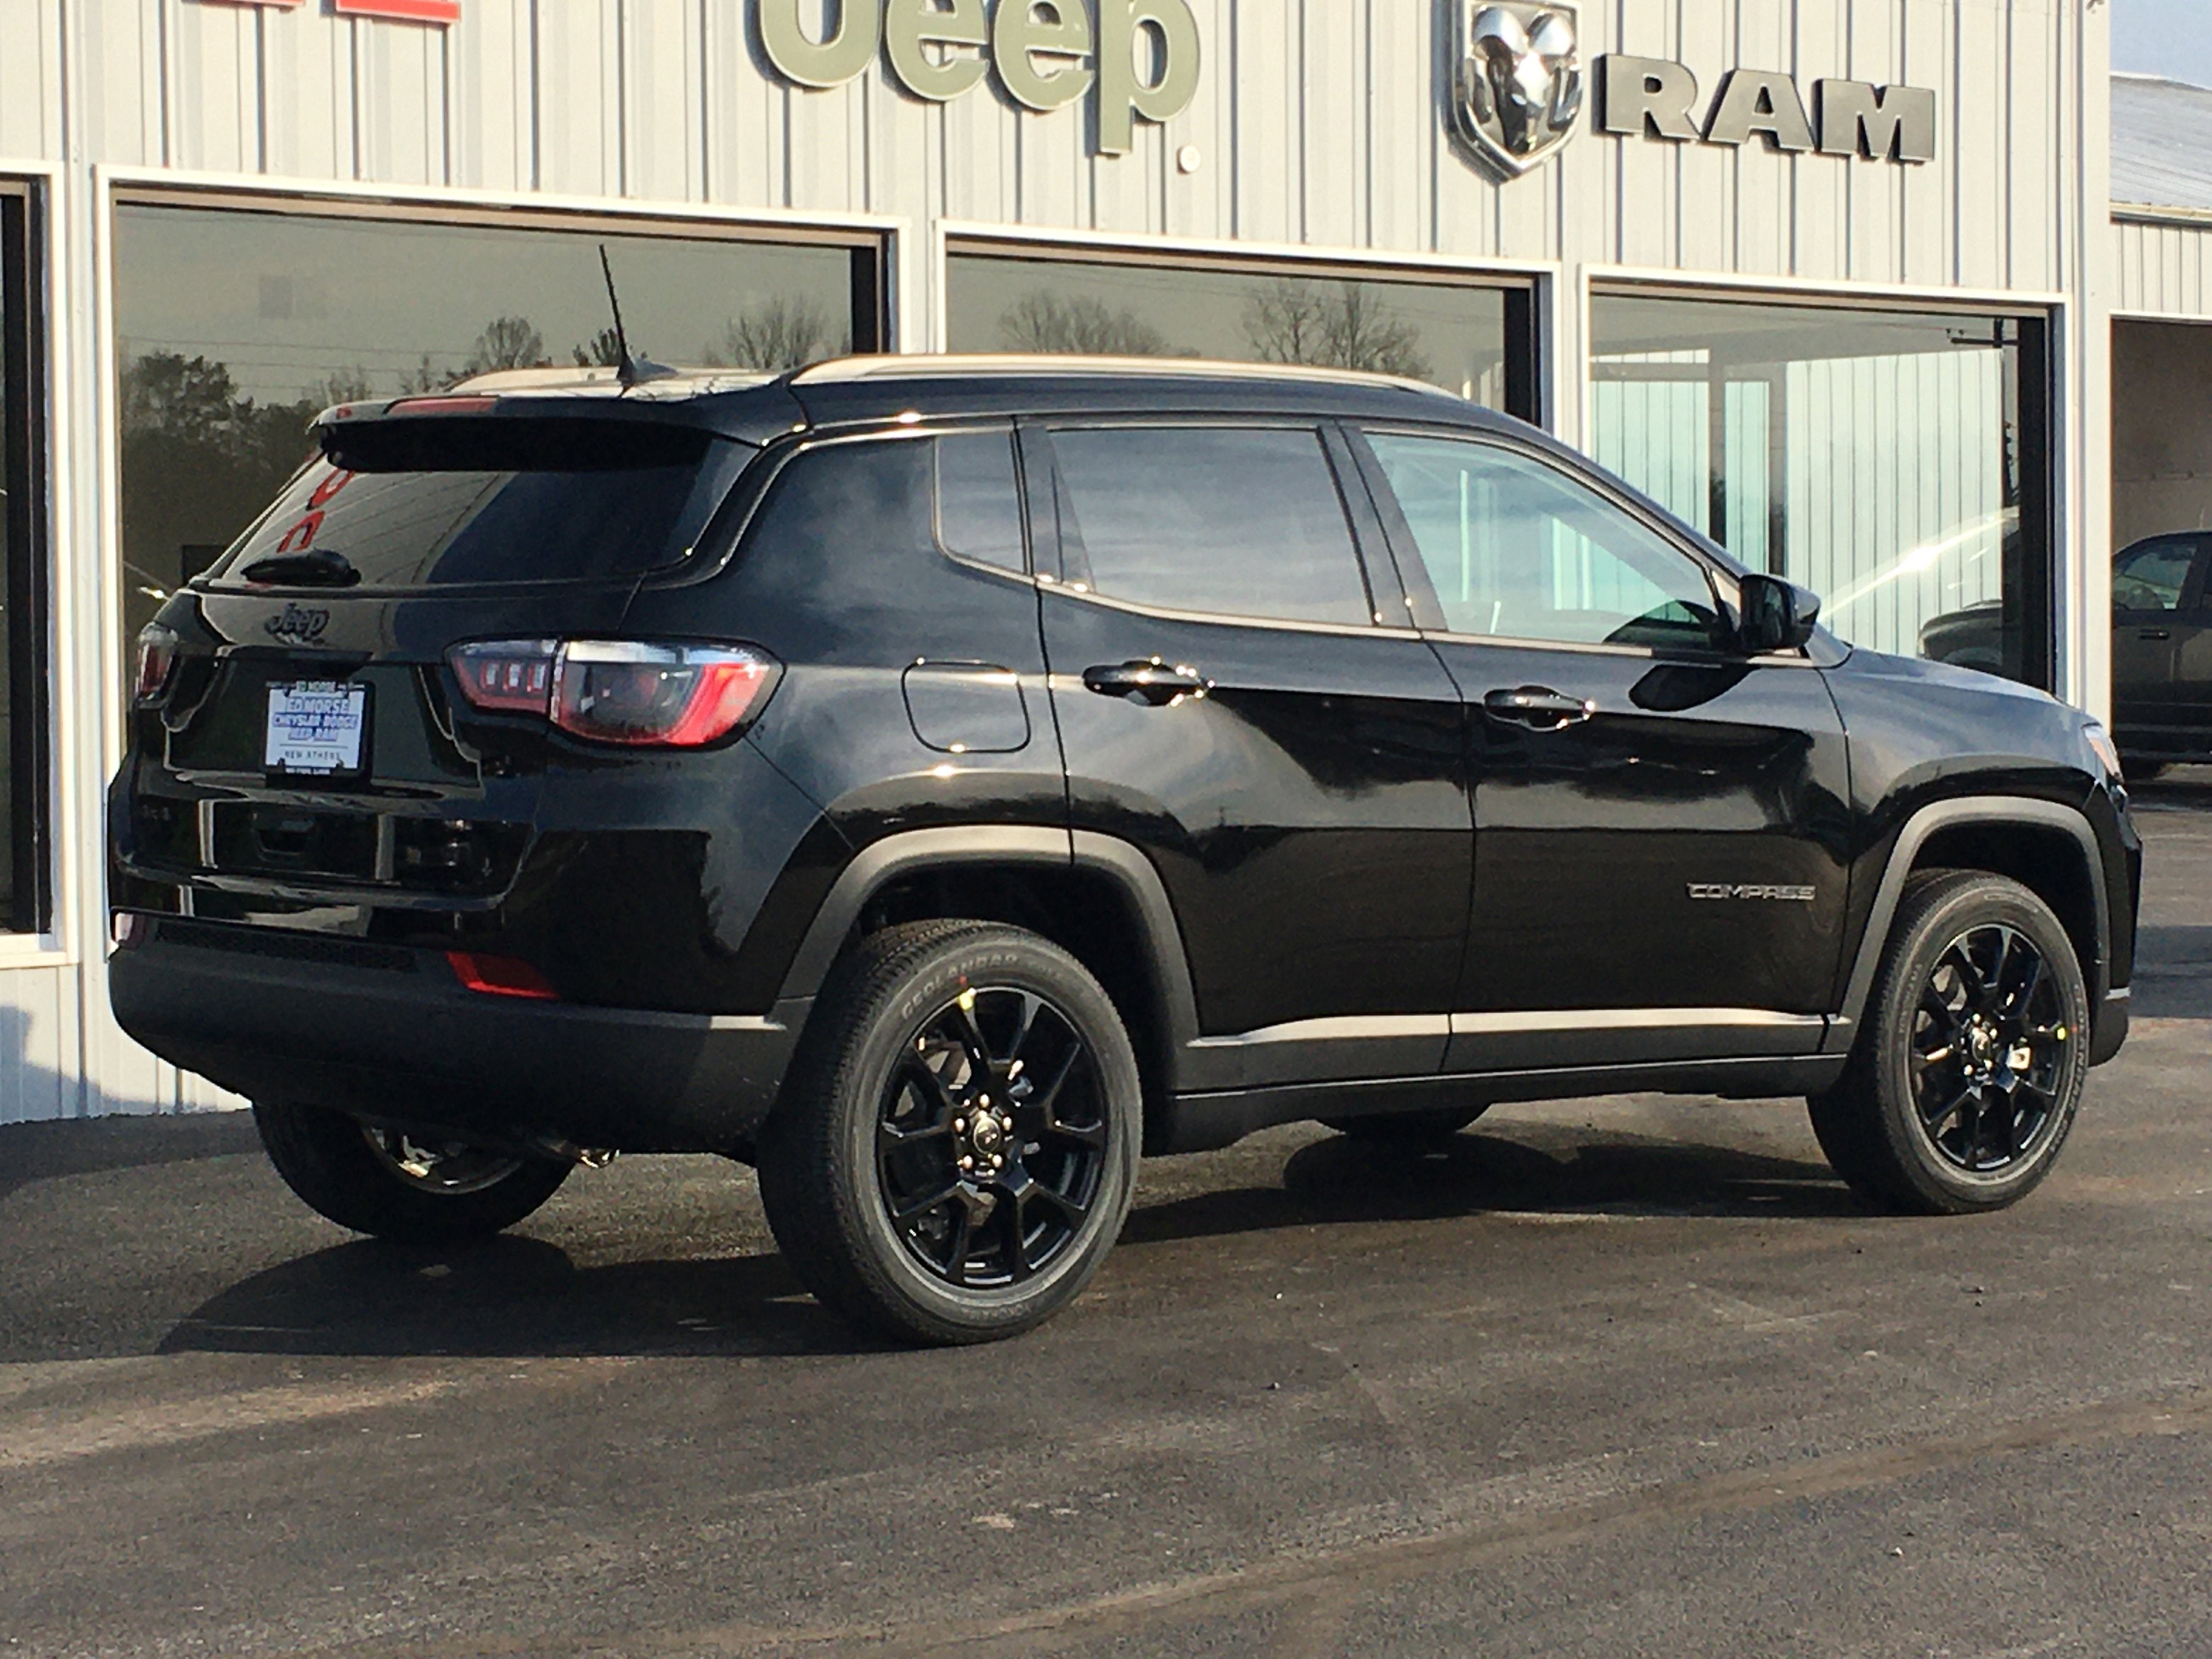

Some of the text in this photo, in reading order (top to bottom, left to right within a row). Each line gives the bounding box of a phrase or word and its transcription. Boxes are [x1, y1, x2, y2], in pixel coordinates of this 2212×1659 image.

[1600, 53, 1936, 163] RAM
[264, 602, 330, 637] Jeep
[287, 698, 349, 714] ED MORSE
[1686, 882, 1815, 900] COMPASS
